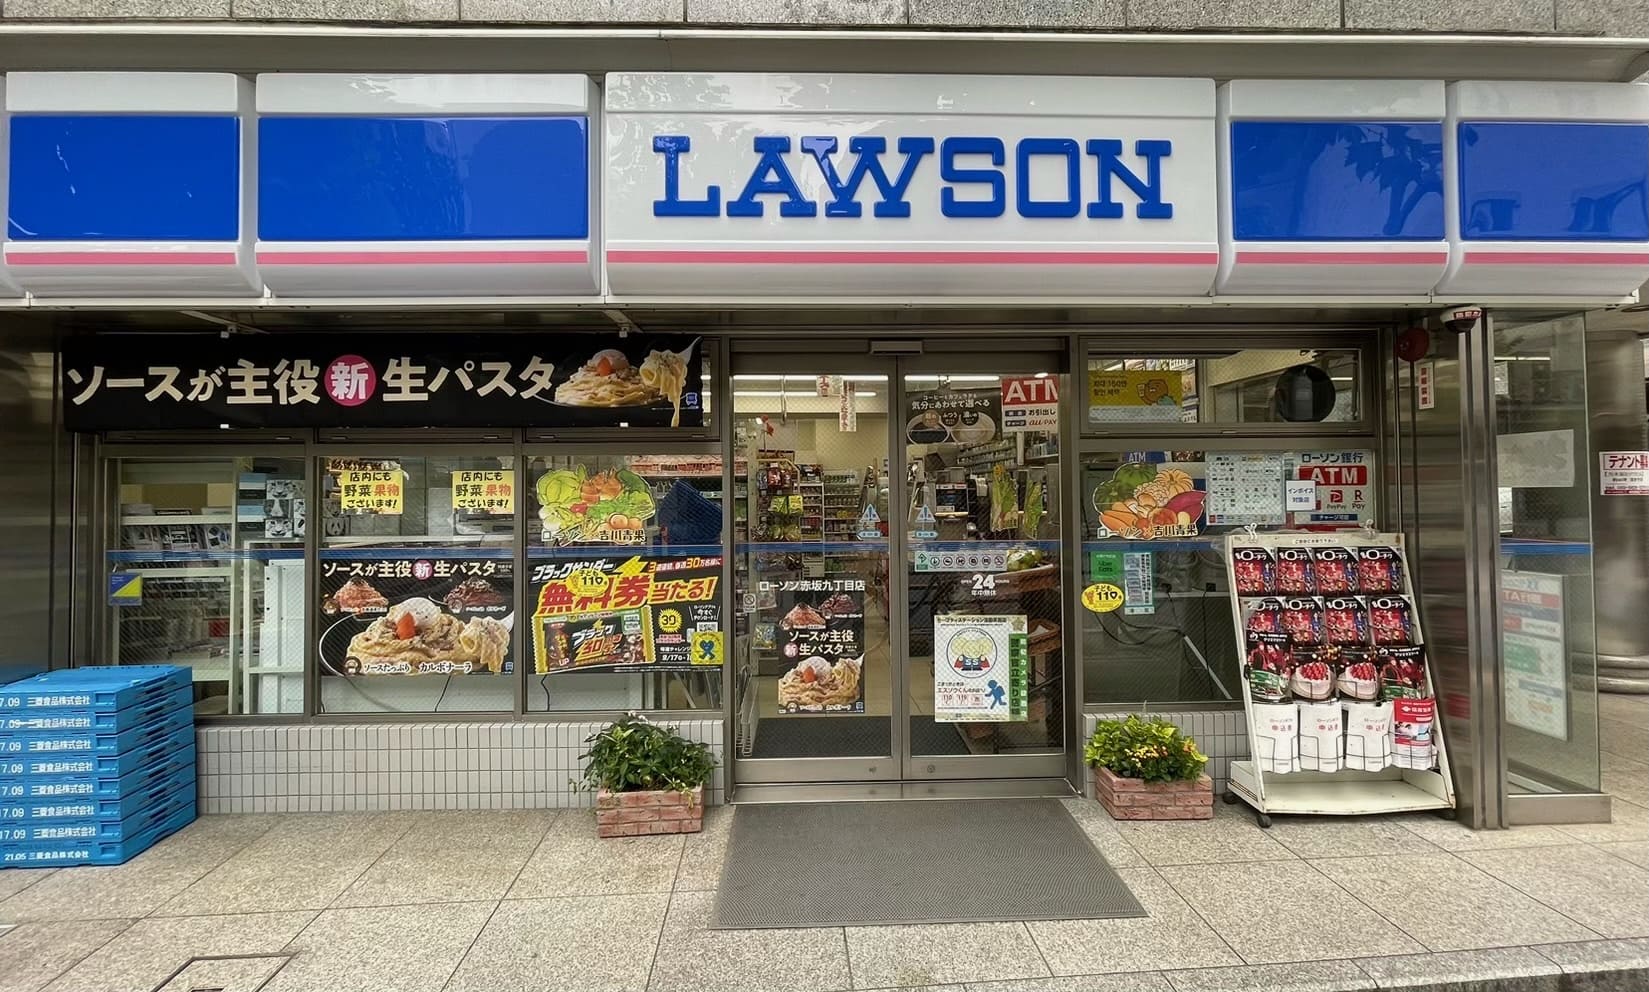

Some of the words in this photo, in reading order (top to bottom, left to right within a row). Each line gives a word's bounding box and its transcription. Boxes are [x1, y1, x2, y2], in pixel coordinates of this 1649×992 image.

[652, 135, 1173, 219] LAWSON
[911, 399, 991, 410] 気分にあわせて選べる
[1028, 408, 1056, 416] お引出し
[1301, 451, 1364, 463] ローソン銀行
[1608, 455, 1640, 468] テナント
[350, 471, 392, 482] 店内にも
[461, 471, 503, 482] 店内にも
[1311, 467, 1359, 484] ATM
[599, 528, 645, 542] 吉川青果
[1153, 524, 1197, 537] 吉川青果
[759, 579, 866, 592] ローソン赤坂九丁目店
[972, 573, 995, 590] 24
[788, 629, 855, 642] ソースが主役
[419, 662, 473, 673] カルボナーラ
